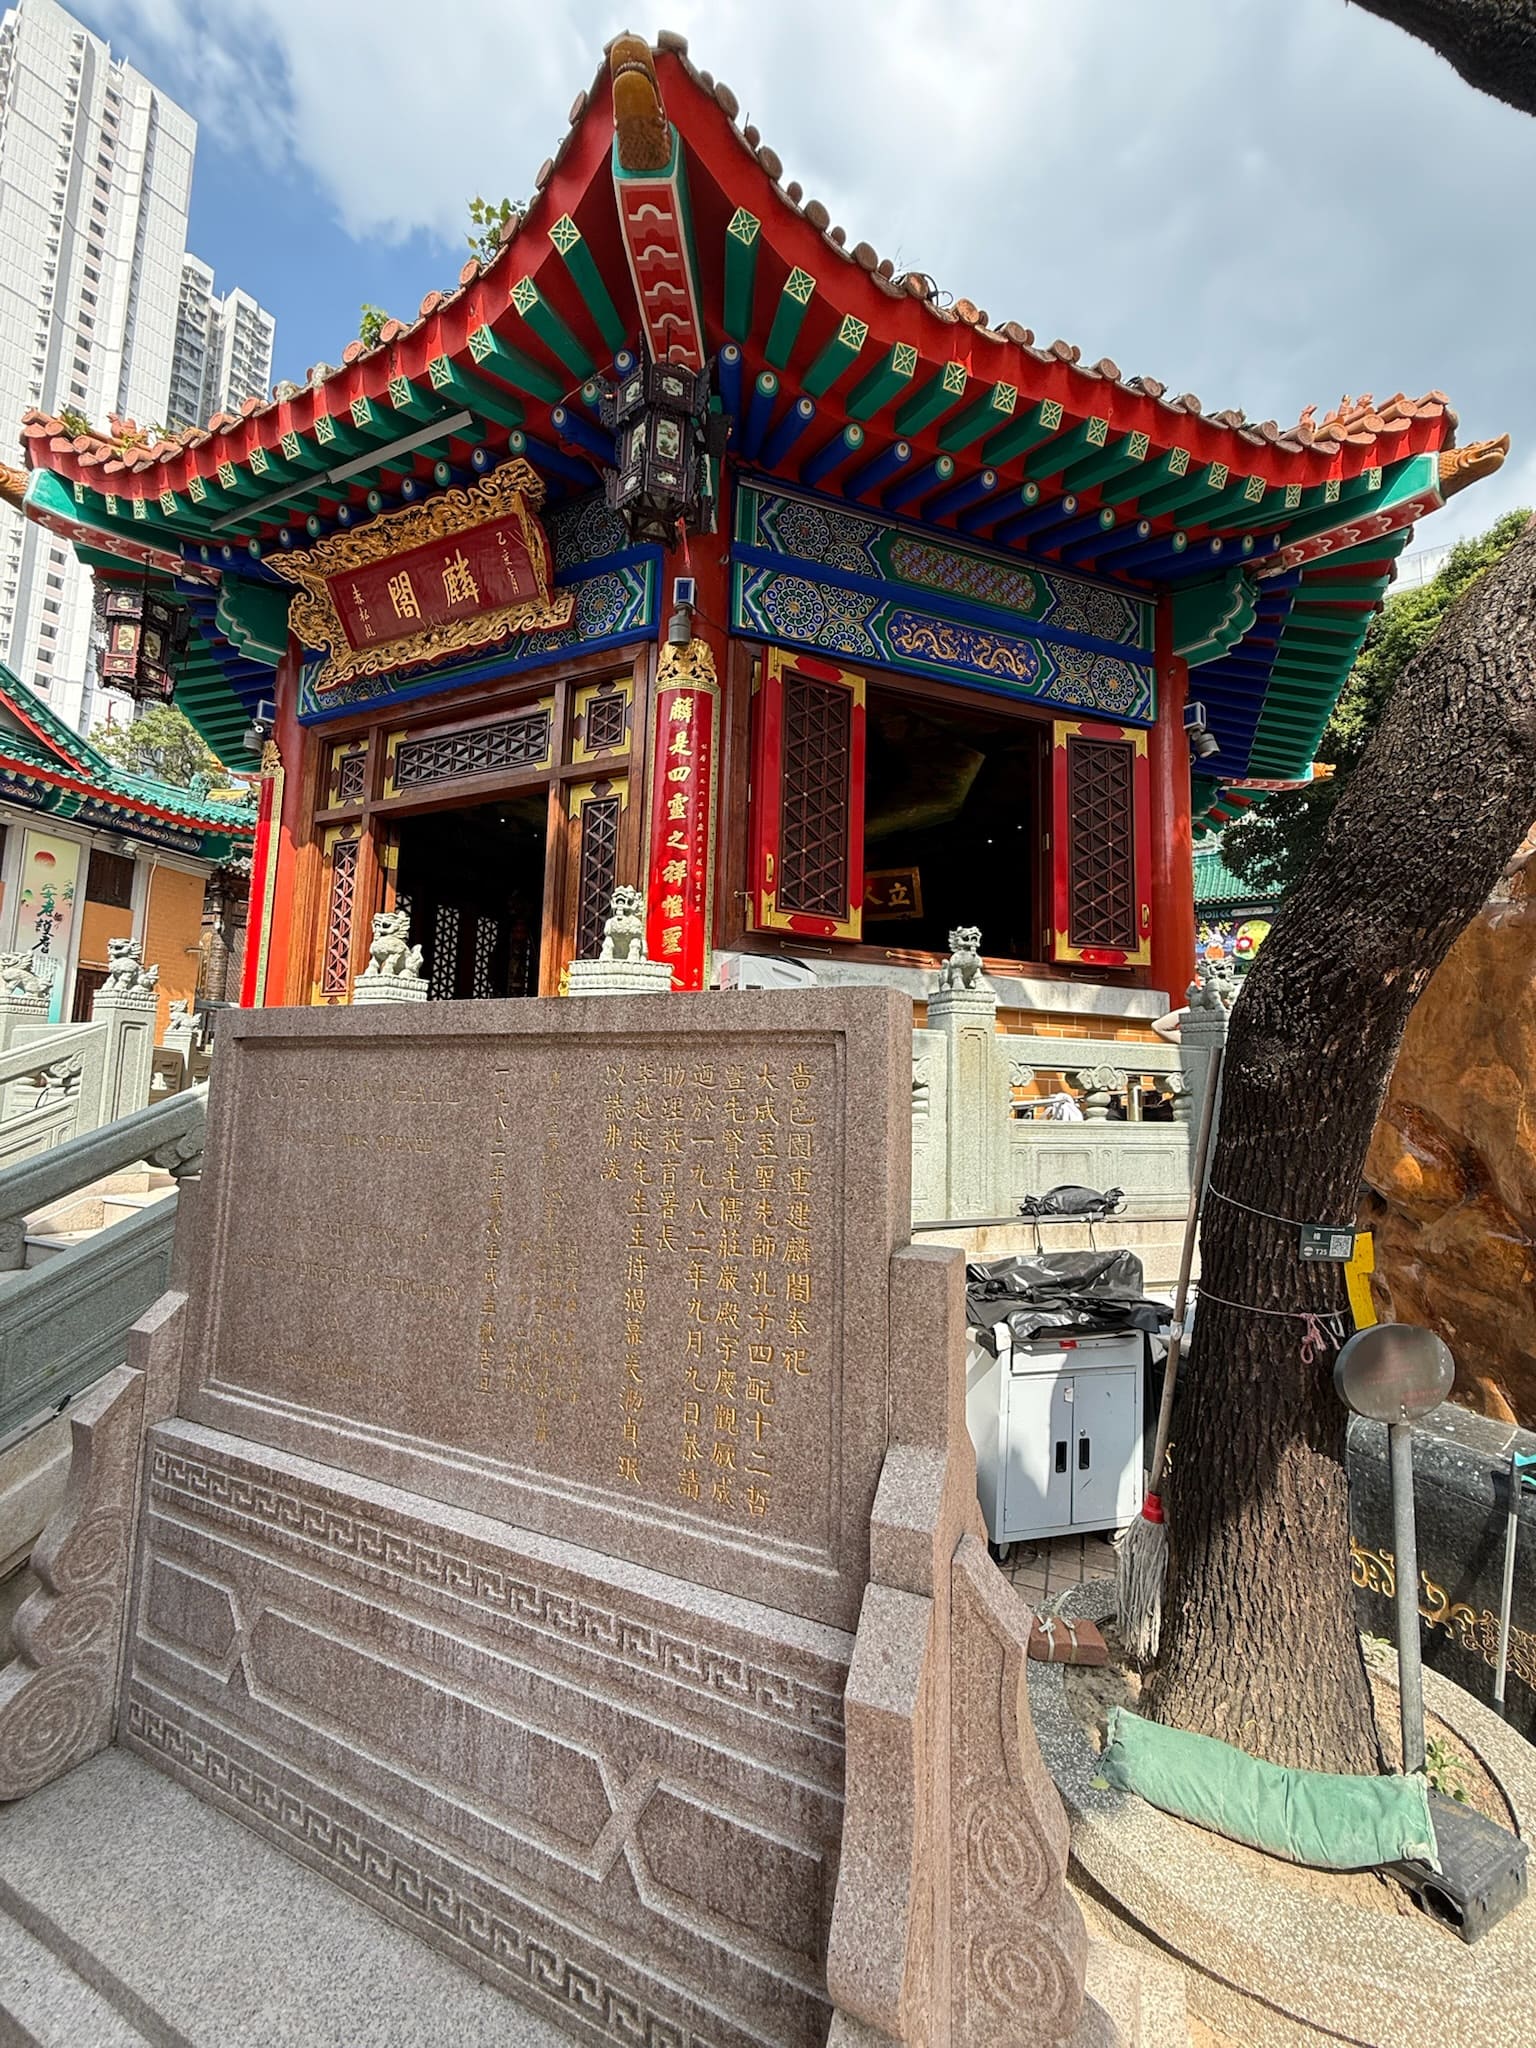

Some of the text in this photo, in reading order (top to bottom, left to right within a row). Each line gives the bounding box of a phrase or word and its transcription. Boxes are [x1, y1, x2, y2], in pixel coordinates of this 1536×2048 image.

[656, 1063, 686, 1254] 助理教育署長
[745, 1064, 780, 1518] 大成至聖先師孔子四配十二哲
